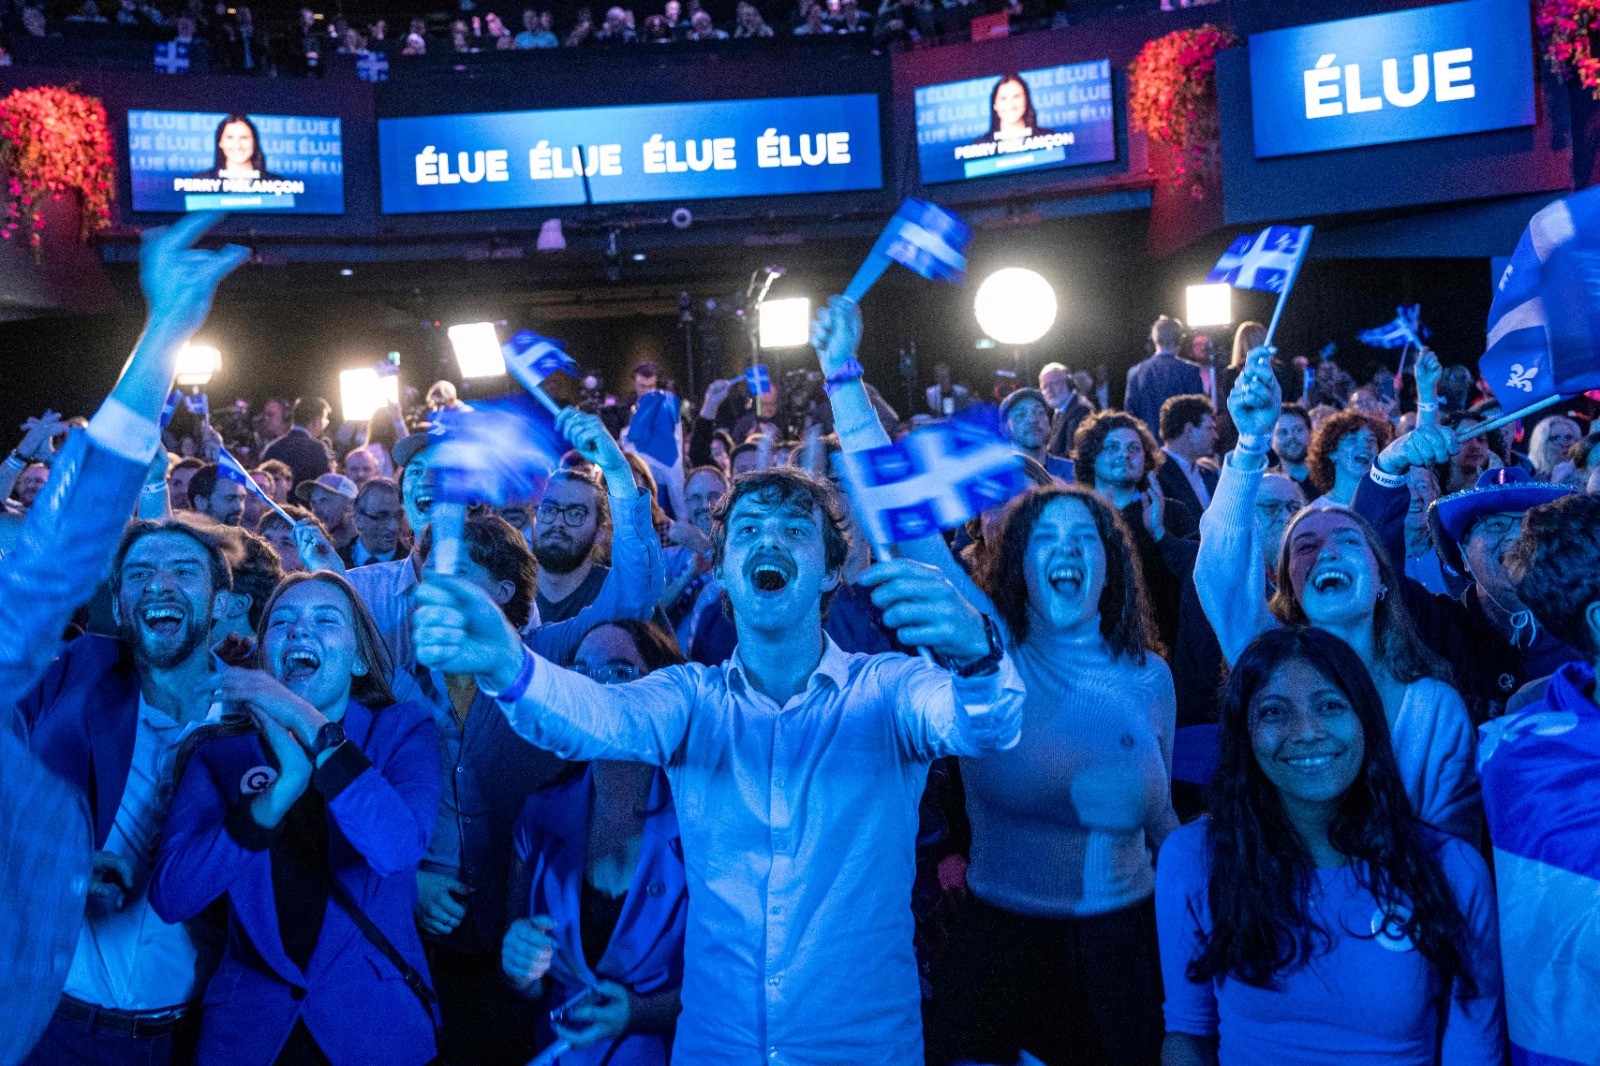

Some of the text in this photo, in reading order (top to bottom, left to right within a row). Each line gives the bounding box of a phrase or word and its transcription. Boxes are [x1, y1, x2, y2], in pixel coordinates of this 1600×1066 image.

[1304, 48, 1475, 119] ÉLUE
[415, 128, 851, 185] ÉLUE ÉLUE ÉLUE ÉLUE
